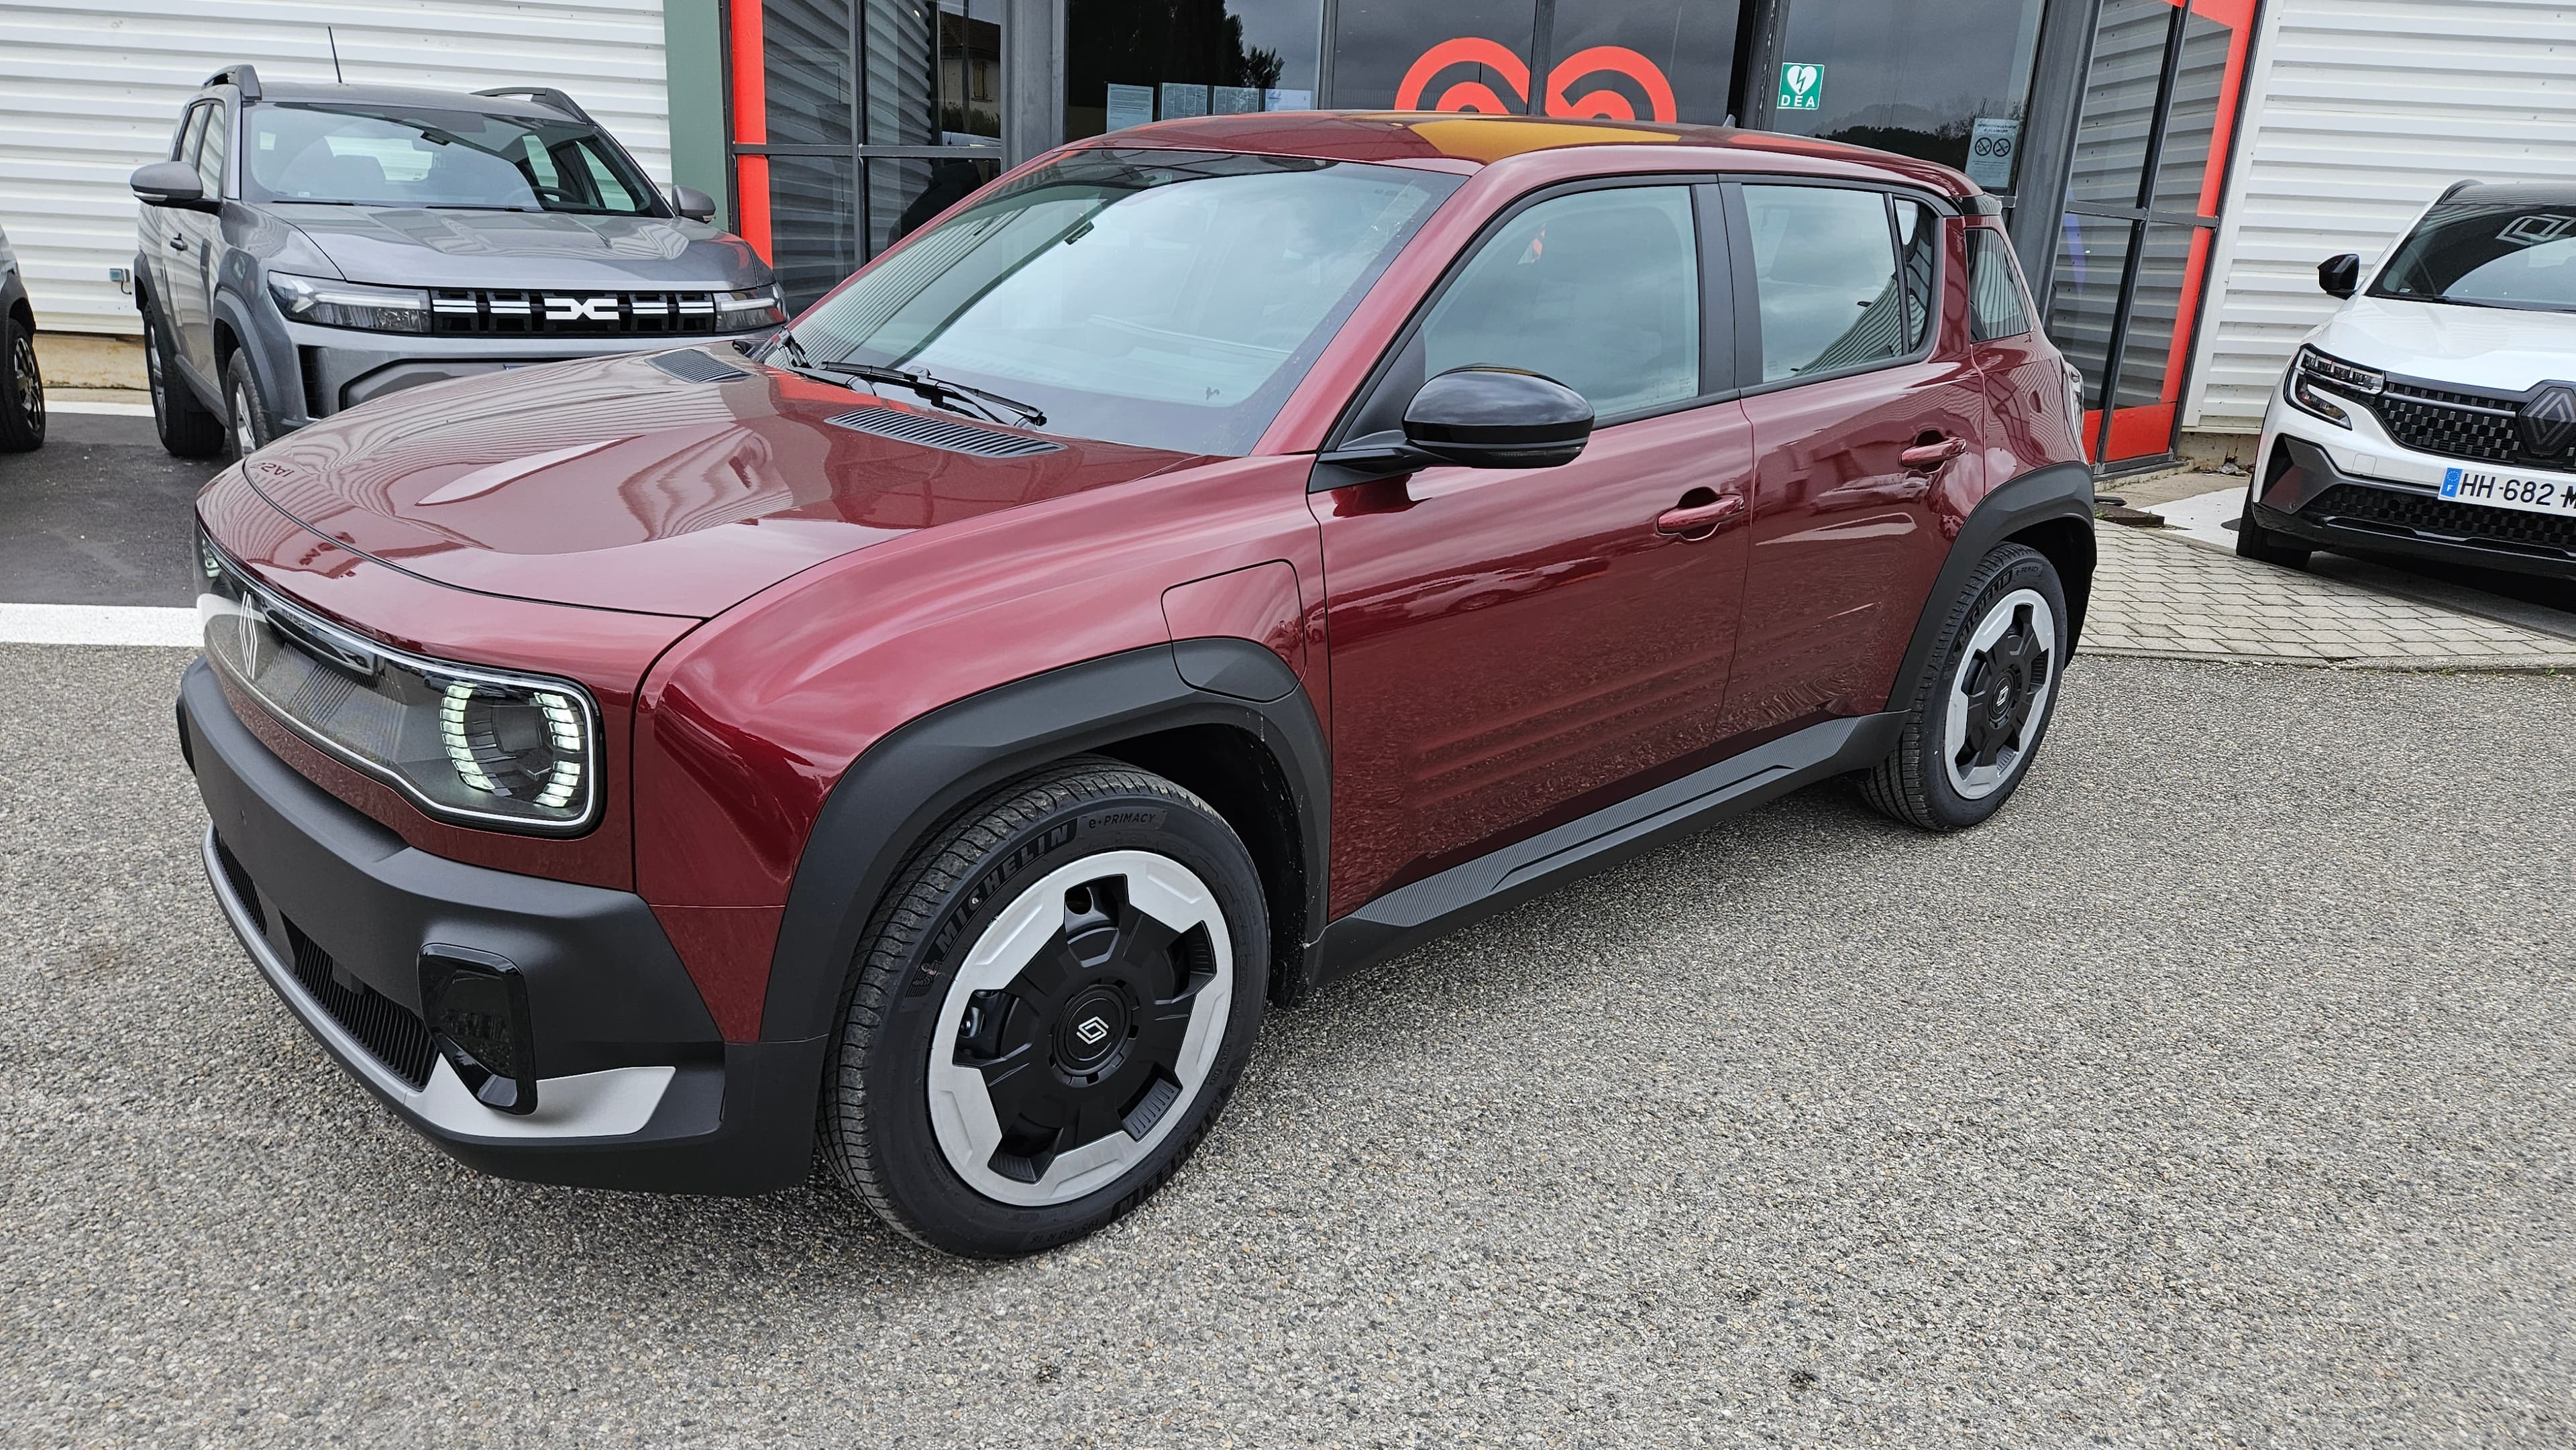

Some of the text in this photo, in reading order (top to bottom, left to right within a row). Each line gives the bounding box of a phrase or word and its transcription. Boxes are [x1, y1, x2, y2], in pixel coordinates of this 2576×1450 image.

[1780, 95, 1815, 107] DEA
[2446, 484, 2453, 492] F
[1959, 572, 2010, 647] MICHELIN
[936, 823, 1069, 952] MICHELIN
